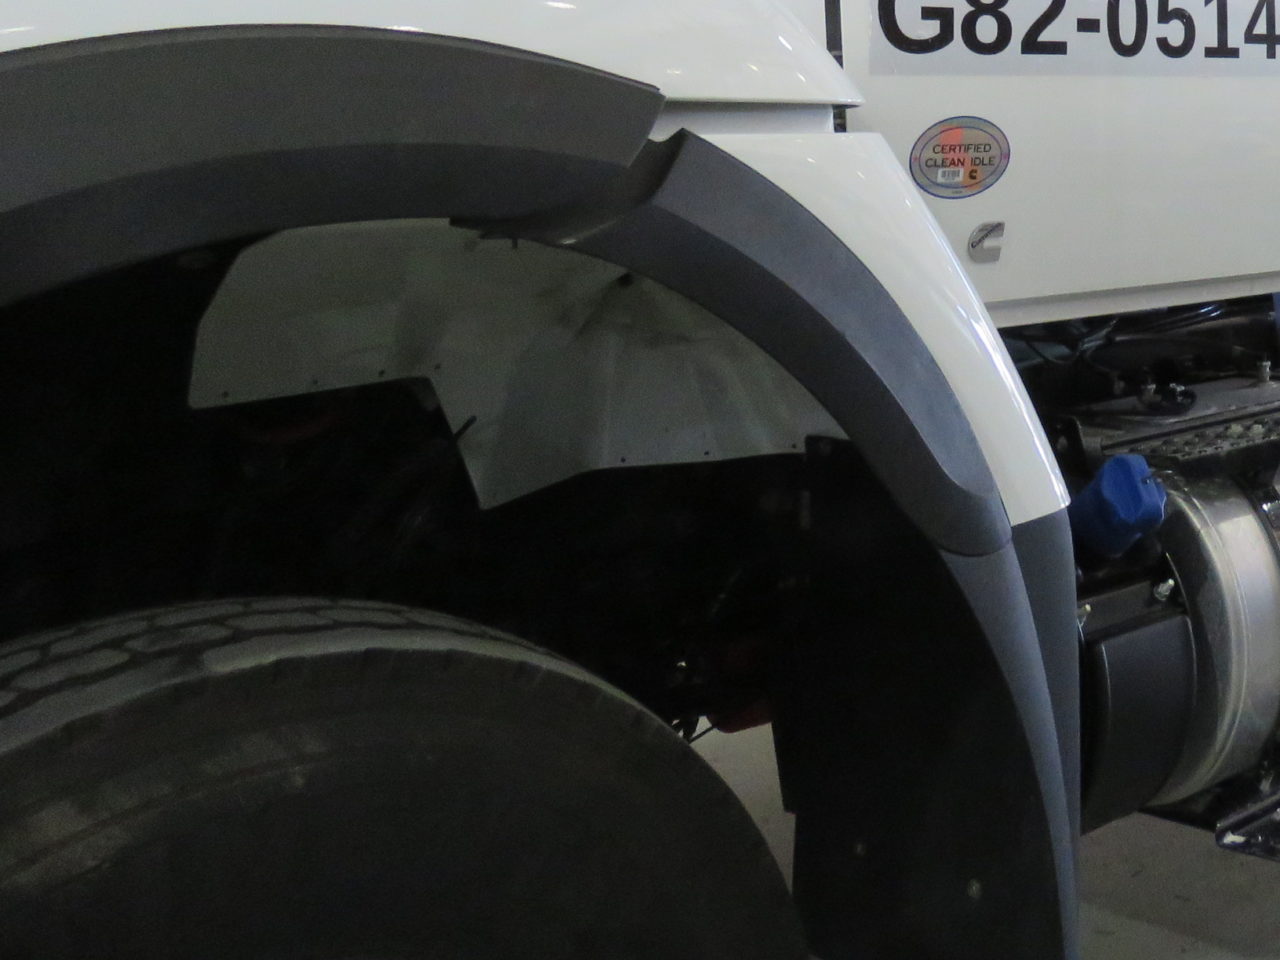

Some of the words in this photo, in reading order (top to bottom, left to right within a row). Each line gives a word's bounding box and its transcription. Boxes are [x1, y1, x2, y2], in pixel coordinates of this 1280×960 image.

[932, 143, 992, 155] CERTIFIED
[925, 157, 965, 168] CLEAN
[971, 156, 996, 167] IDLE
